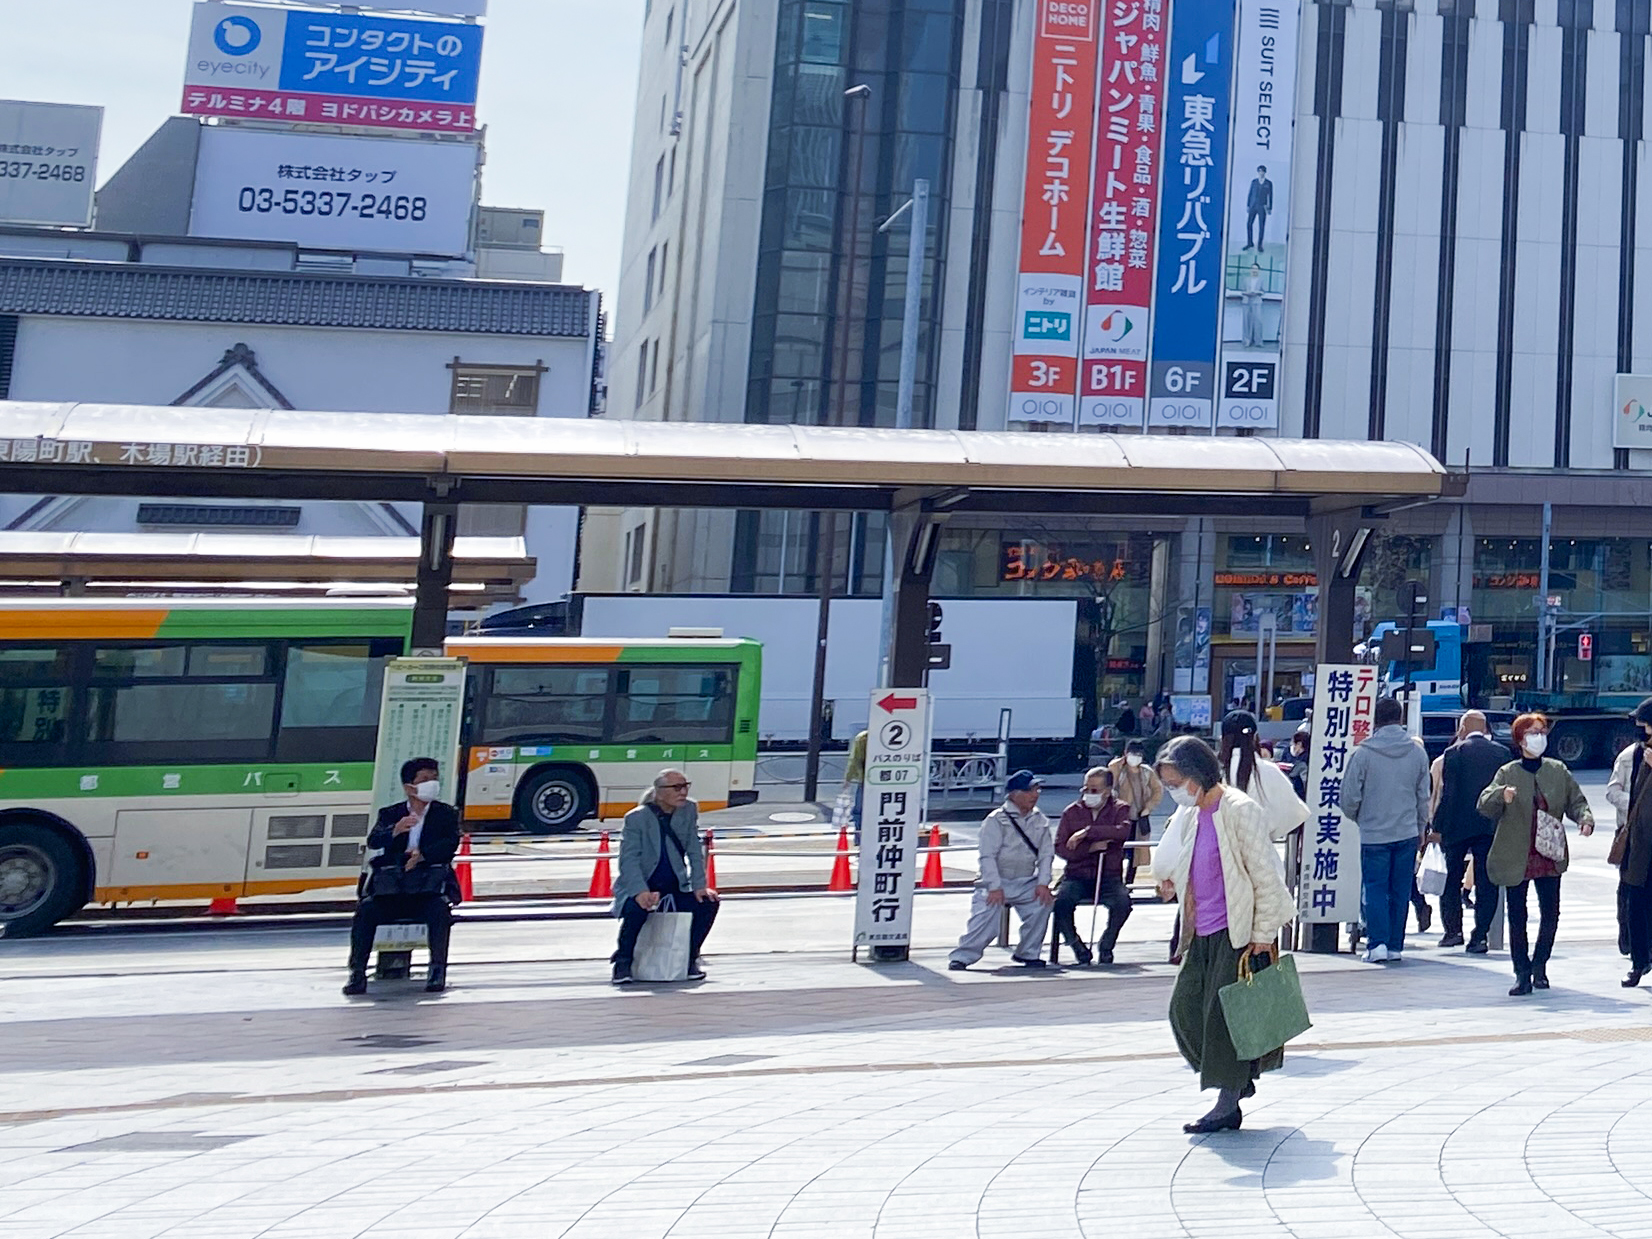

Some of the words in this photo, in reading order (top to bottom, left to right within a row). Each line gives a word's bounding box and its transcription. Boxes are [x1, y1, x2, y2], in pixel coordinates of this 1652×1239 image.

[1049, 1, 1088, 15] DECO
[1049, 14, 1087, 27] HOME
[306, 25, 463, 57] コンタクトの
[1261, 35, 1279, 77] SUIT
[197, 60, 270, 79] eyecity
[303, 52, 459, 90] アイシティ
[1051, 45, 1077, 119] ニトリ
[187, 92, 306, 116] テルミナ4階
[321, 102, 472, 128] ヨドバシカメラ上
[1256, 80, 1274, 150] SELECT
[1095, 0, 1140, 292] ジャパンミート生鮮館
[278, 164, 397, 184] 株式会社タップ
[239, 187, 427, 222] 03-5337-2468
[1039, 130, 1074, 257] デコホーム
[1171, 94, 1216, 294] 東急リバブル
[1043, 297, 1054, 306] by
[1027, 317, 1067, 334] ニトリ
[1028, 361, 1061, 386] 3F
[1091, 364, 1136, 390] B1F
[1165, 366, 1201, 392] 6F
[1232, 368, 1269, 393] 2F
[1332, 529, 1340, 558] 2
[872, 753, 921, 763] バスのりば
[1311, 670, 1354, 917] 特別対策実施中
[872, 791, 907, 923] 門前仲町行
